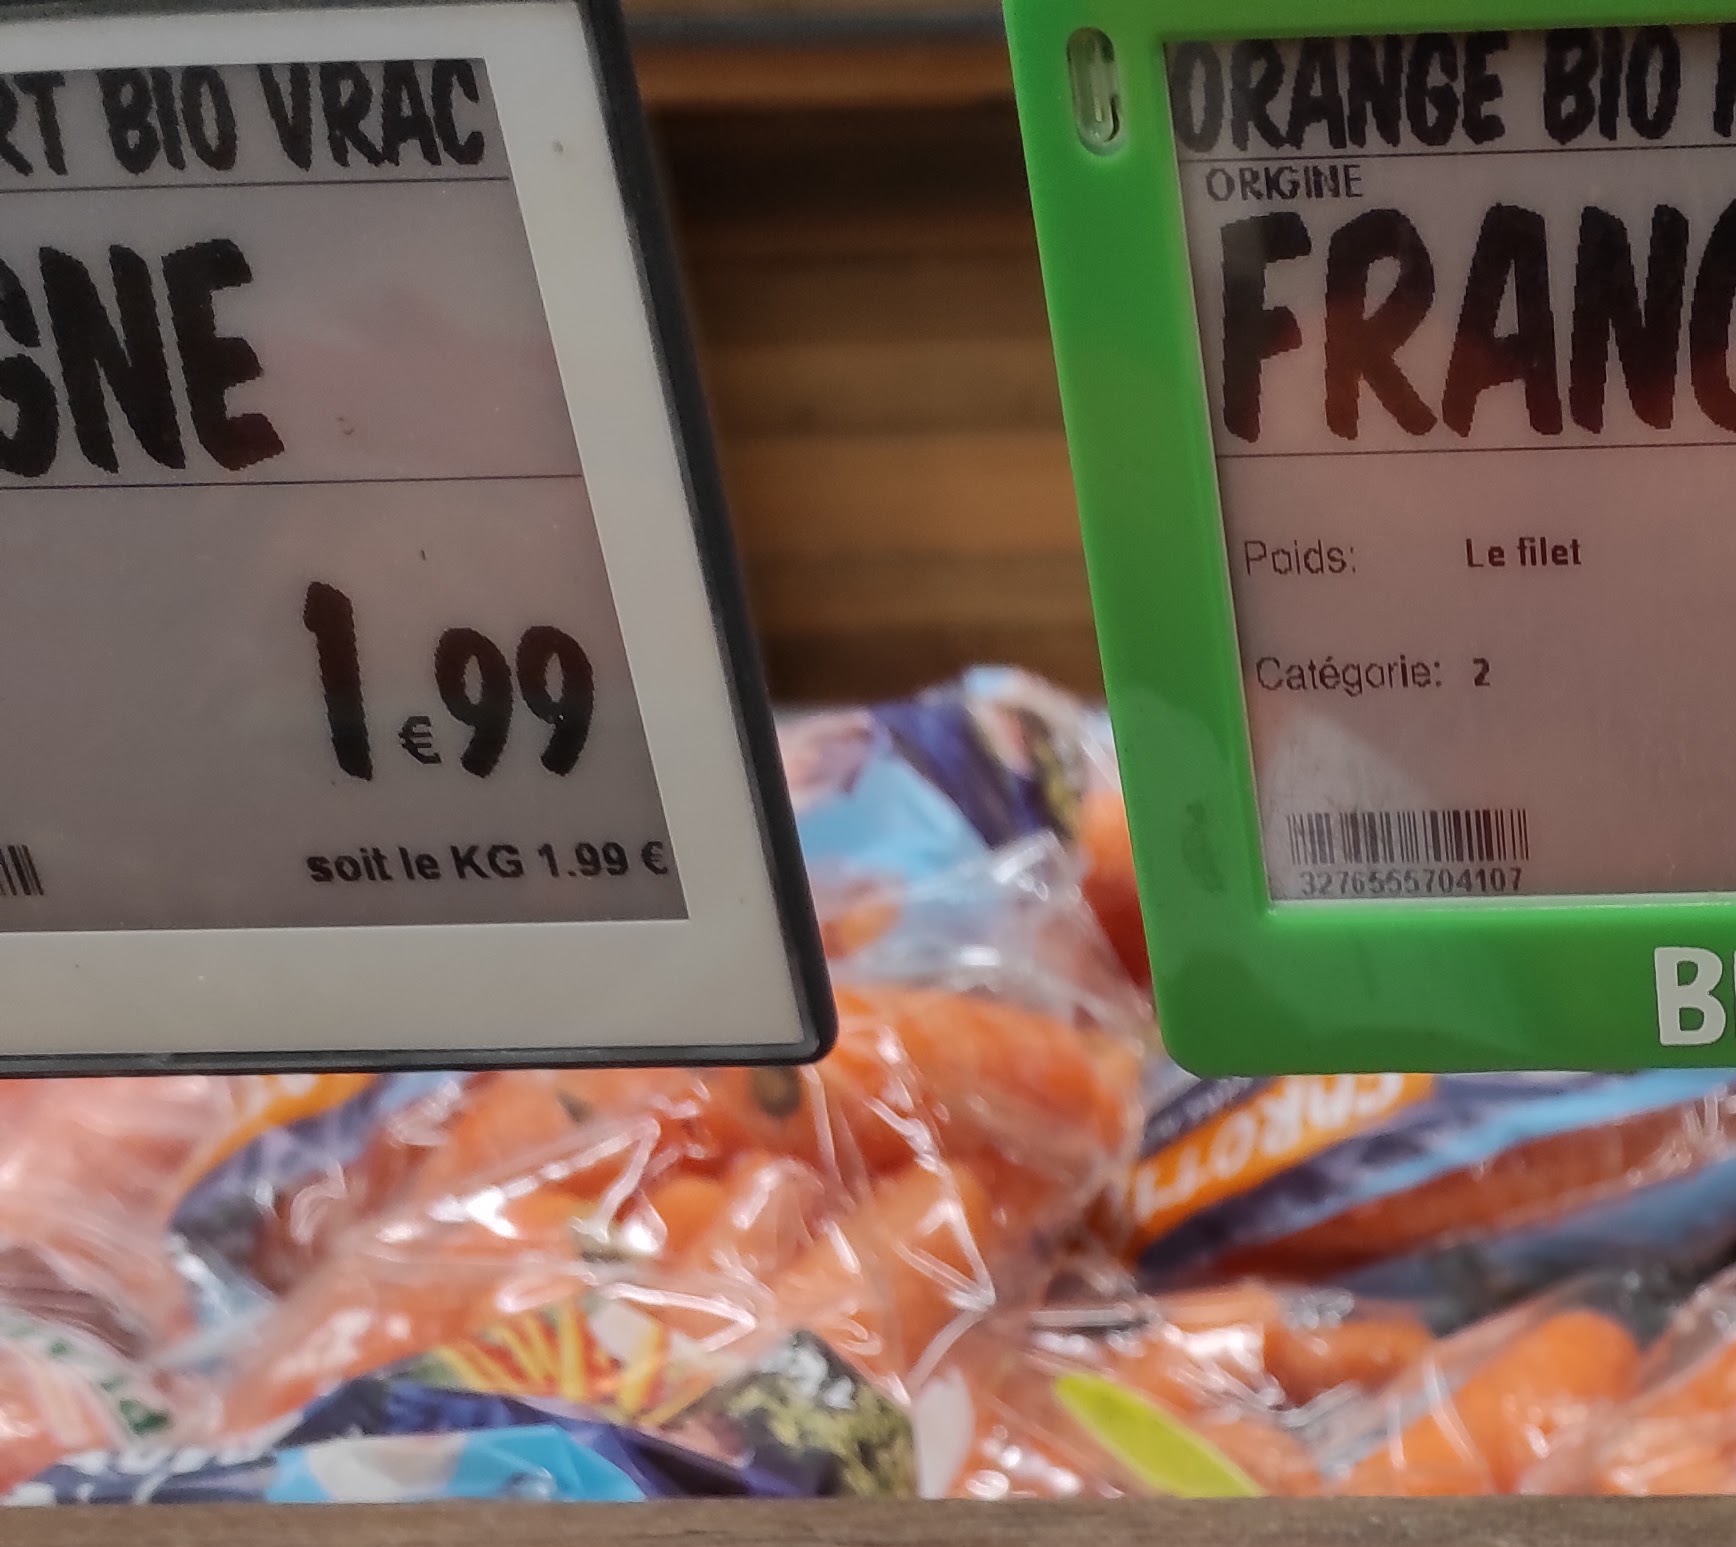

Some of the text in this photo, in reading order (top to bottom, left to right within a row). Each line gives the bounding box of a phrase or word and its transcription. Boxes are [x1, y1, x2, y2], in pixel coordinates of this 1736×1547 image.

[1170, 31, 1511, 152] ORANGE
[1542, 25, 1682, 144] BIO
[101, 66, 237, 173] BIO
[259, 60, 485, 173] VRAC
[1206, 164, 1362, 203] ORIGINE
[1244, 536, 1582, 576] Poids: Le filet
[1256, 654, 1491, 697] Catégorie: 2
[306, 840, 669, 883] soit le KG 1.99 €
[1301, 867, 1523, 896] 3276555704107
